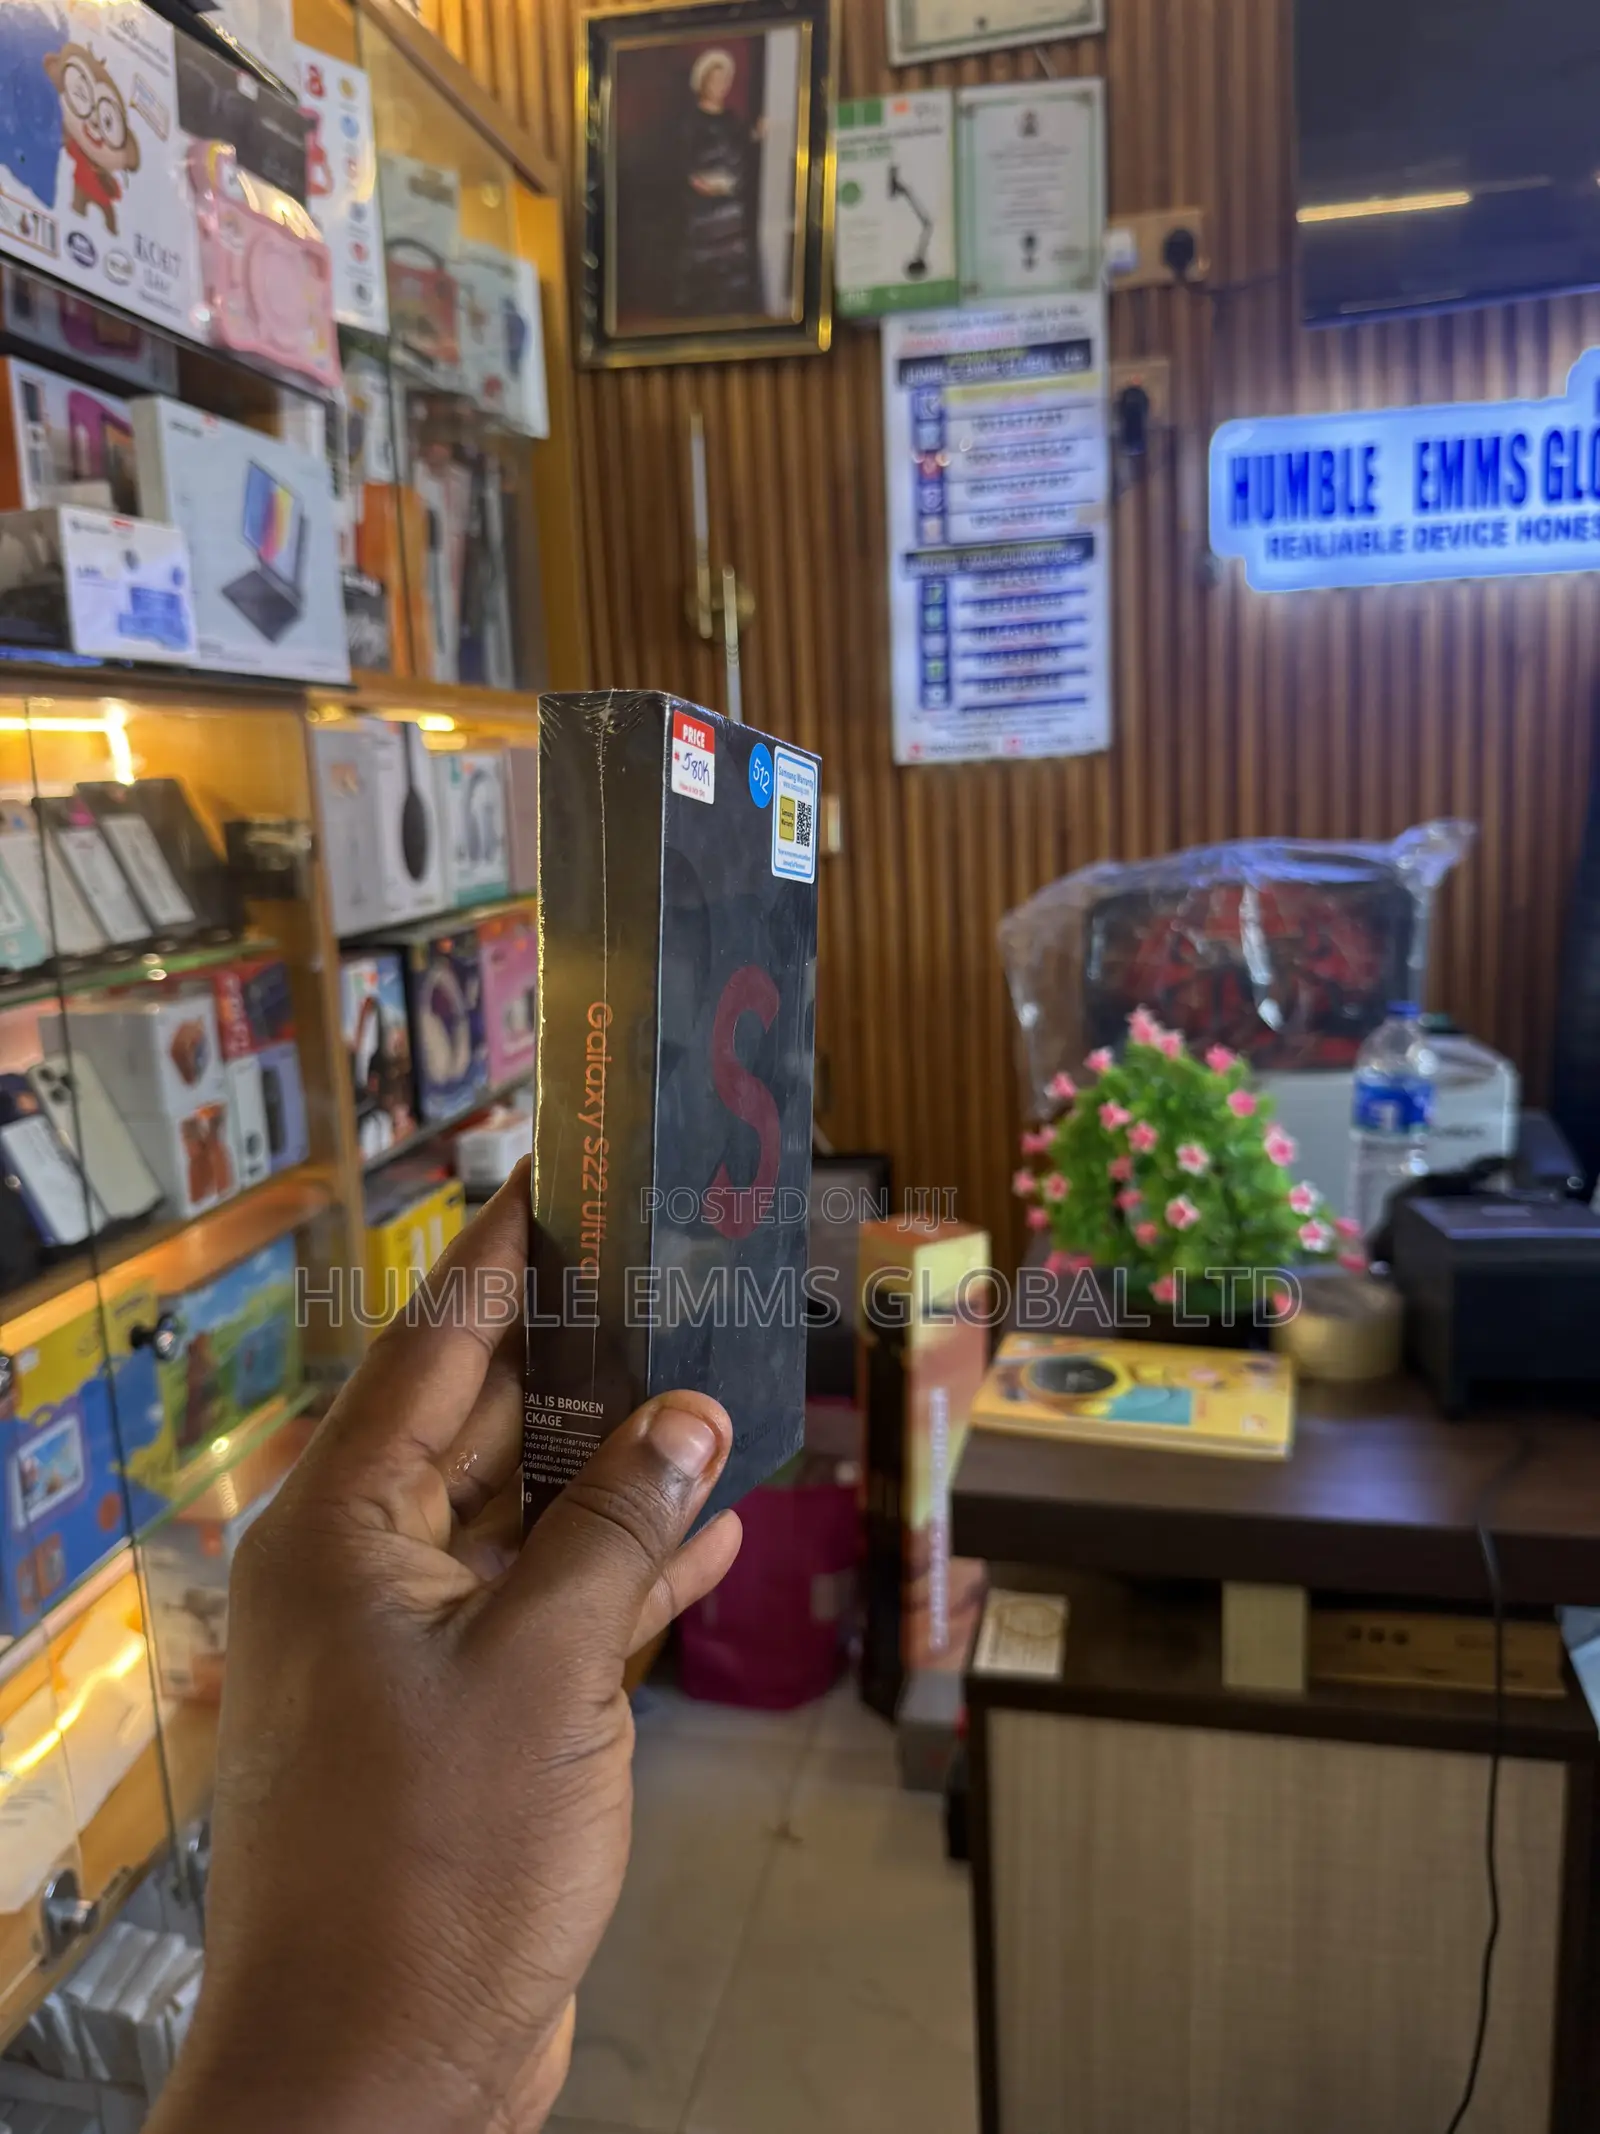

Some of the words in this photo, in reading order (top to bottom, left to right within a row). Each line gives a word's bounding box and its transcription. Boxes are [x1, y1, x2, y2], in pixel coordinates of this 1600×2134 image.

[1230, 446, 1378, 528] HUMBLE
[1413, 433, 1529, 514] EMMS
[1412, 520, 1509, 553] DEVICE
[682, 723, 706, 748] PRICE
[752, 758, 770, 795] 512
[577, 1001, 613, 1128] Galaxy
[582, 1135, 609, 1192] S22
[580, 1201, 607, 1280] Ultra
[525, 1412, 562, 1427] CKAGE
[545, 1396, 555, 1407] IS
[558, 1398, 604, 1414] BROKEN
[525, 1441, 540, 1449] ence
[548, 1444, 580, 1457] delivering
[550, 1435, 562, 1444] give
[563, 1437, 578, 1446] clear
